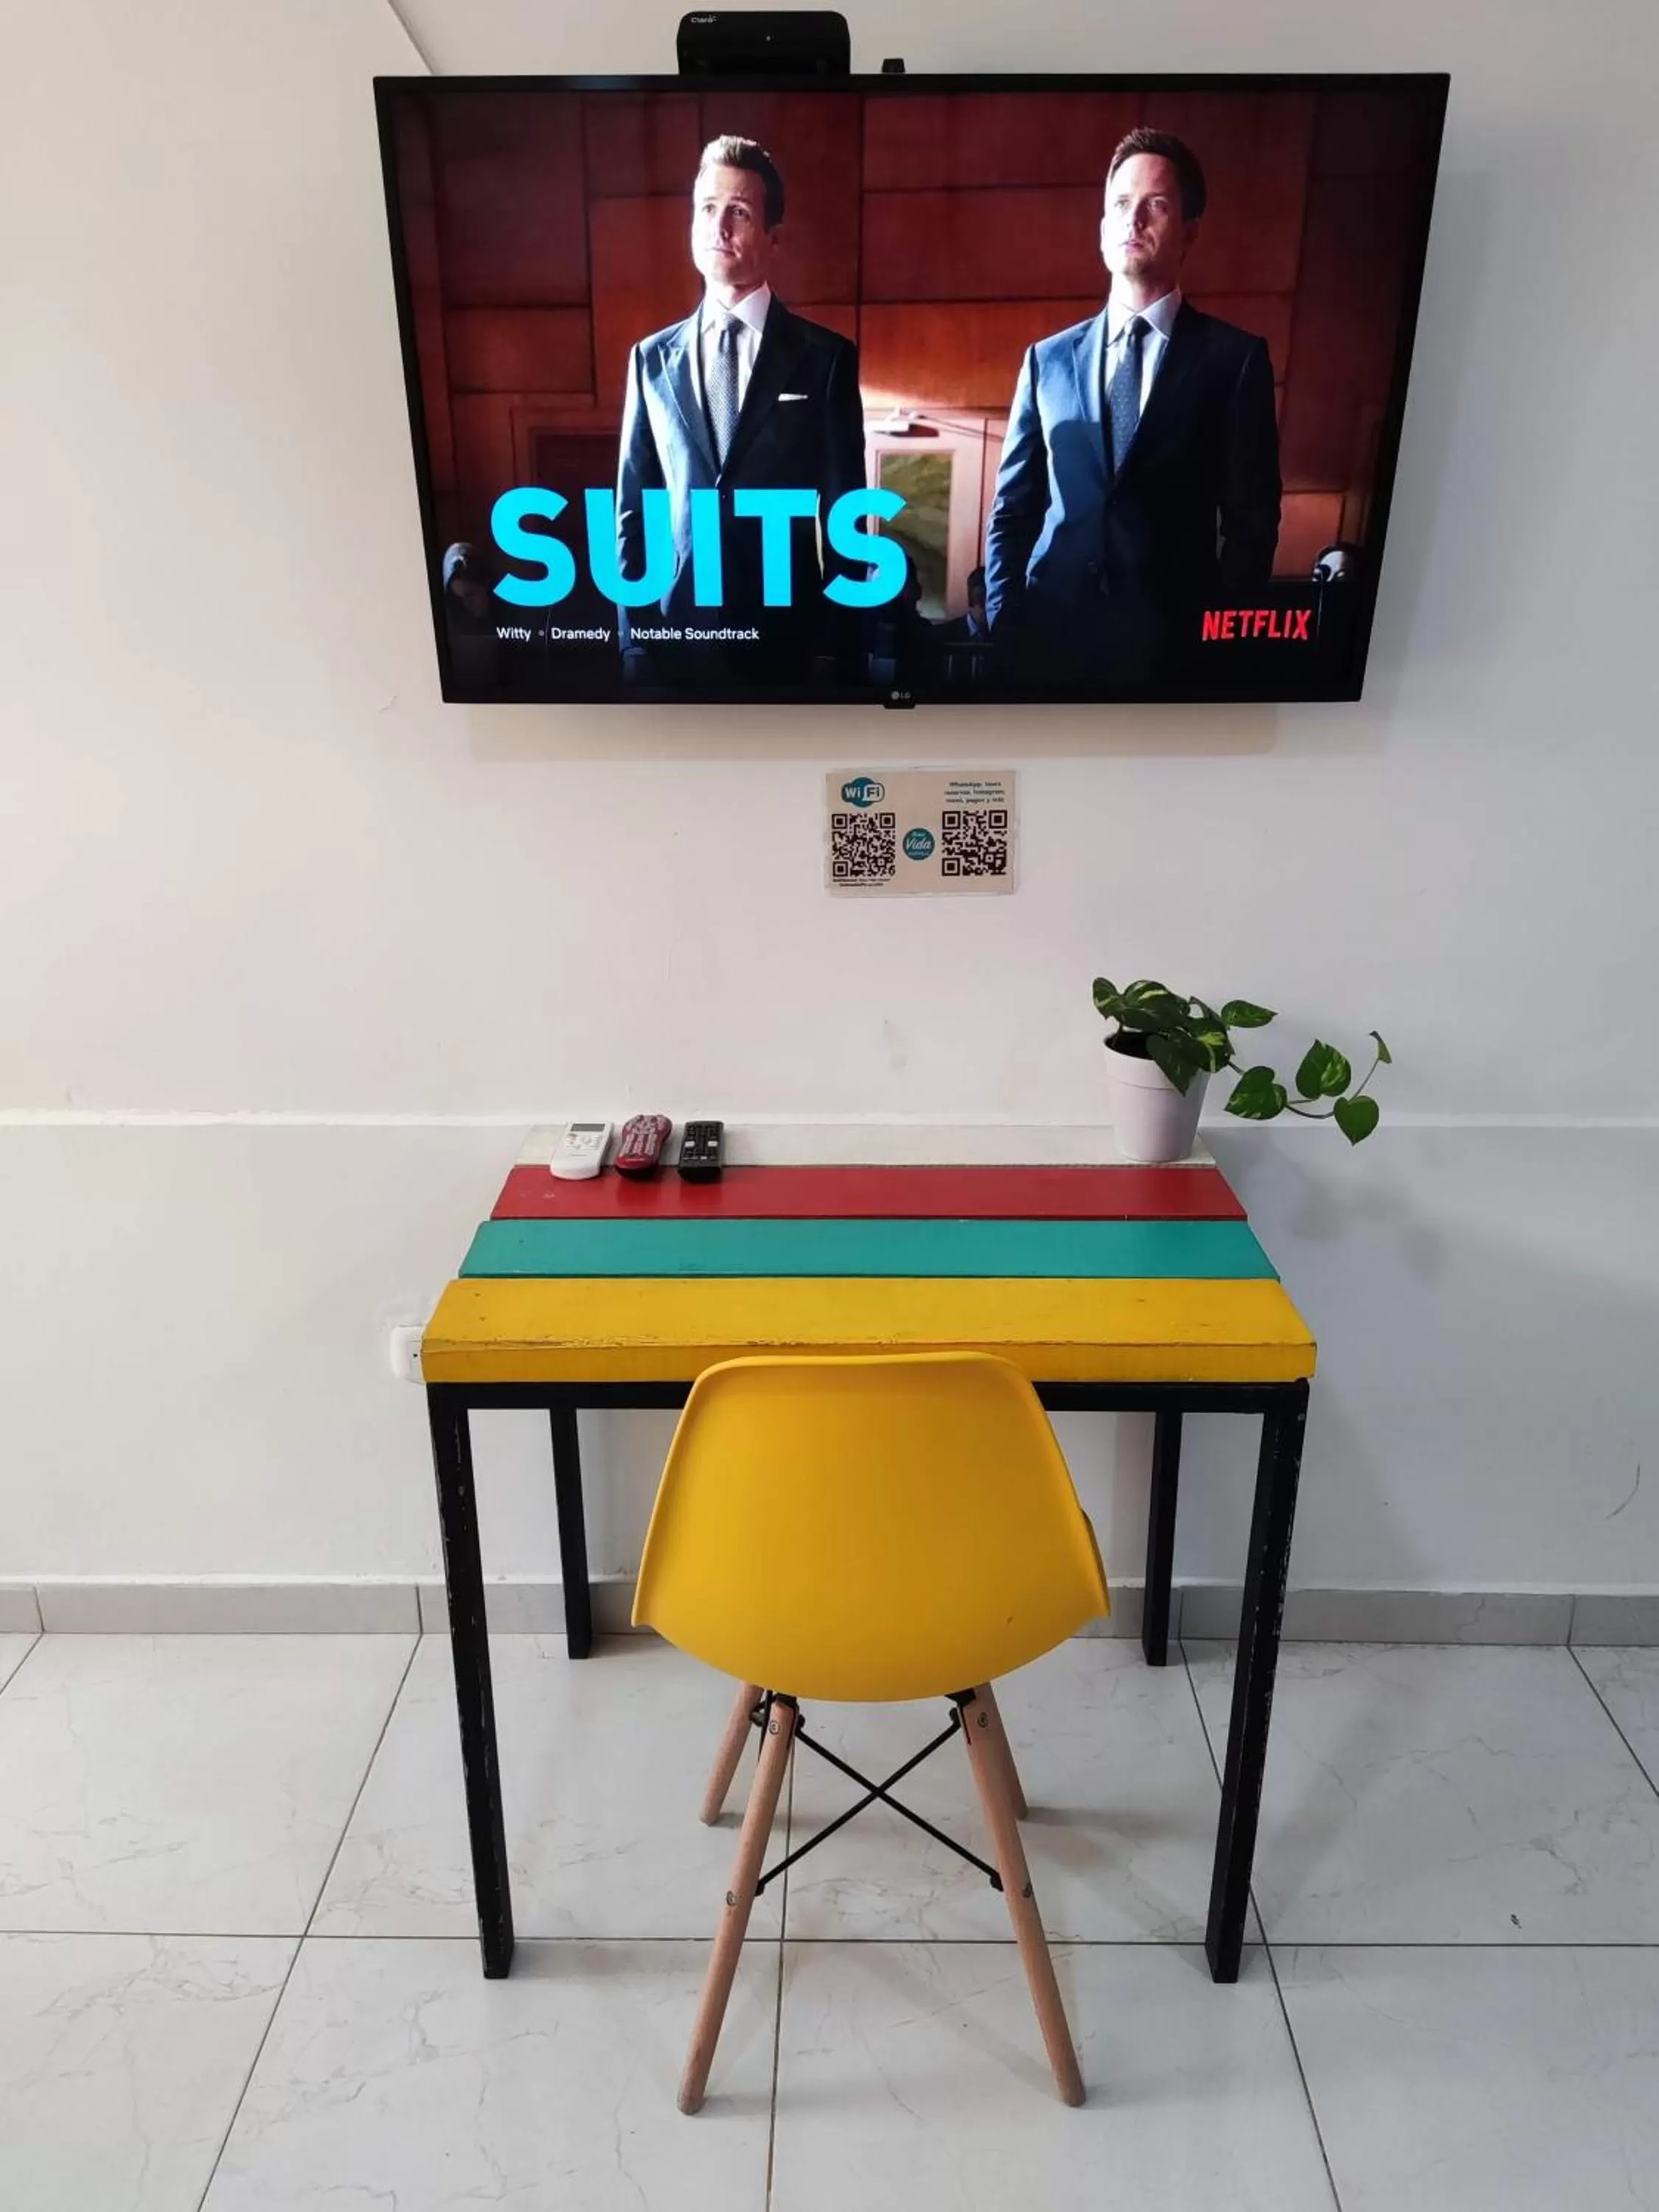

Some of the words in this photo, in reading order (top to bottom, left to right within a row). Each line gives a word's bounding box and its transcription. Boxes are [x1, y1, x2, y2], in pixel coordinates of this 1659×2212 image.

[490, 486, 908, 608] SUITS
[496, 627, 531, 641] Witty
[551, 627, 611, 642] Dramedy
[630, 627, 682, 640] Notable
[685, 627, 760, 640] Soundtrack
[1202, 609, 1312, 641] NETFLIX
[906, 837, 932, 850] Vida
